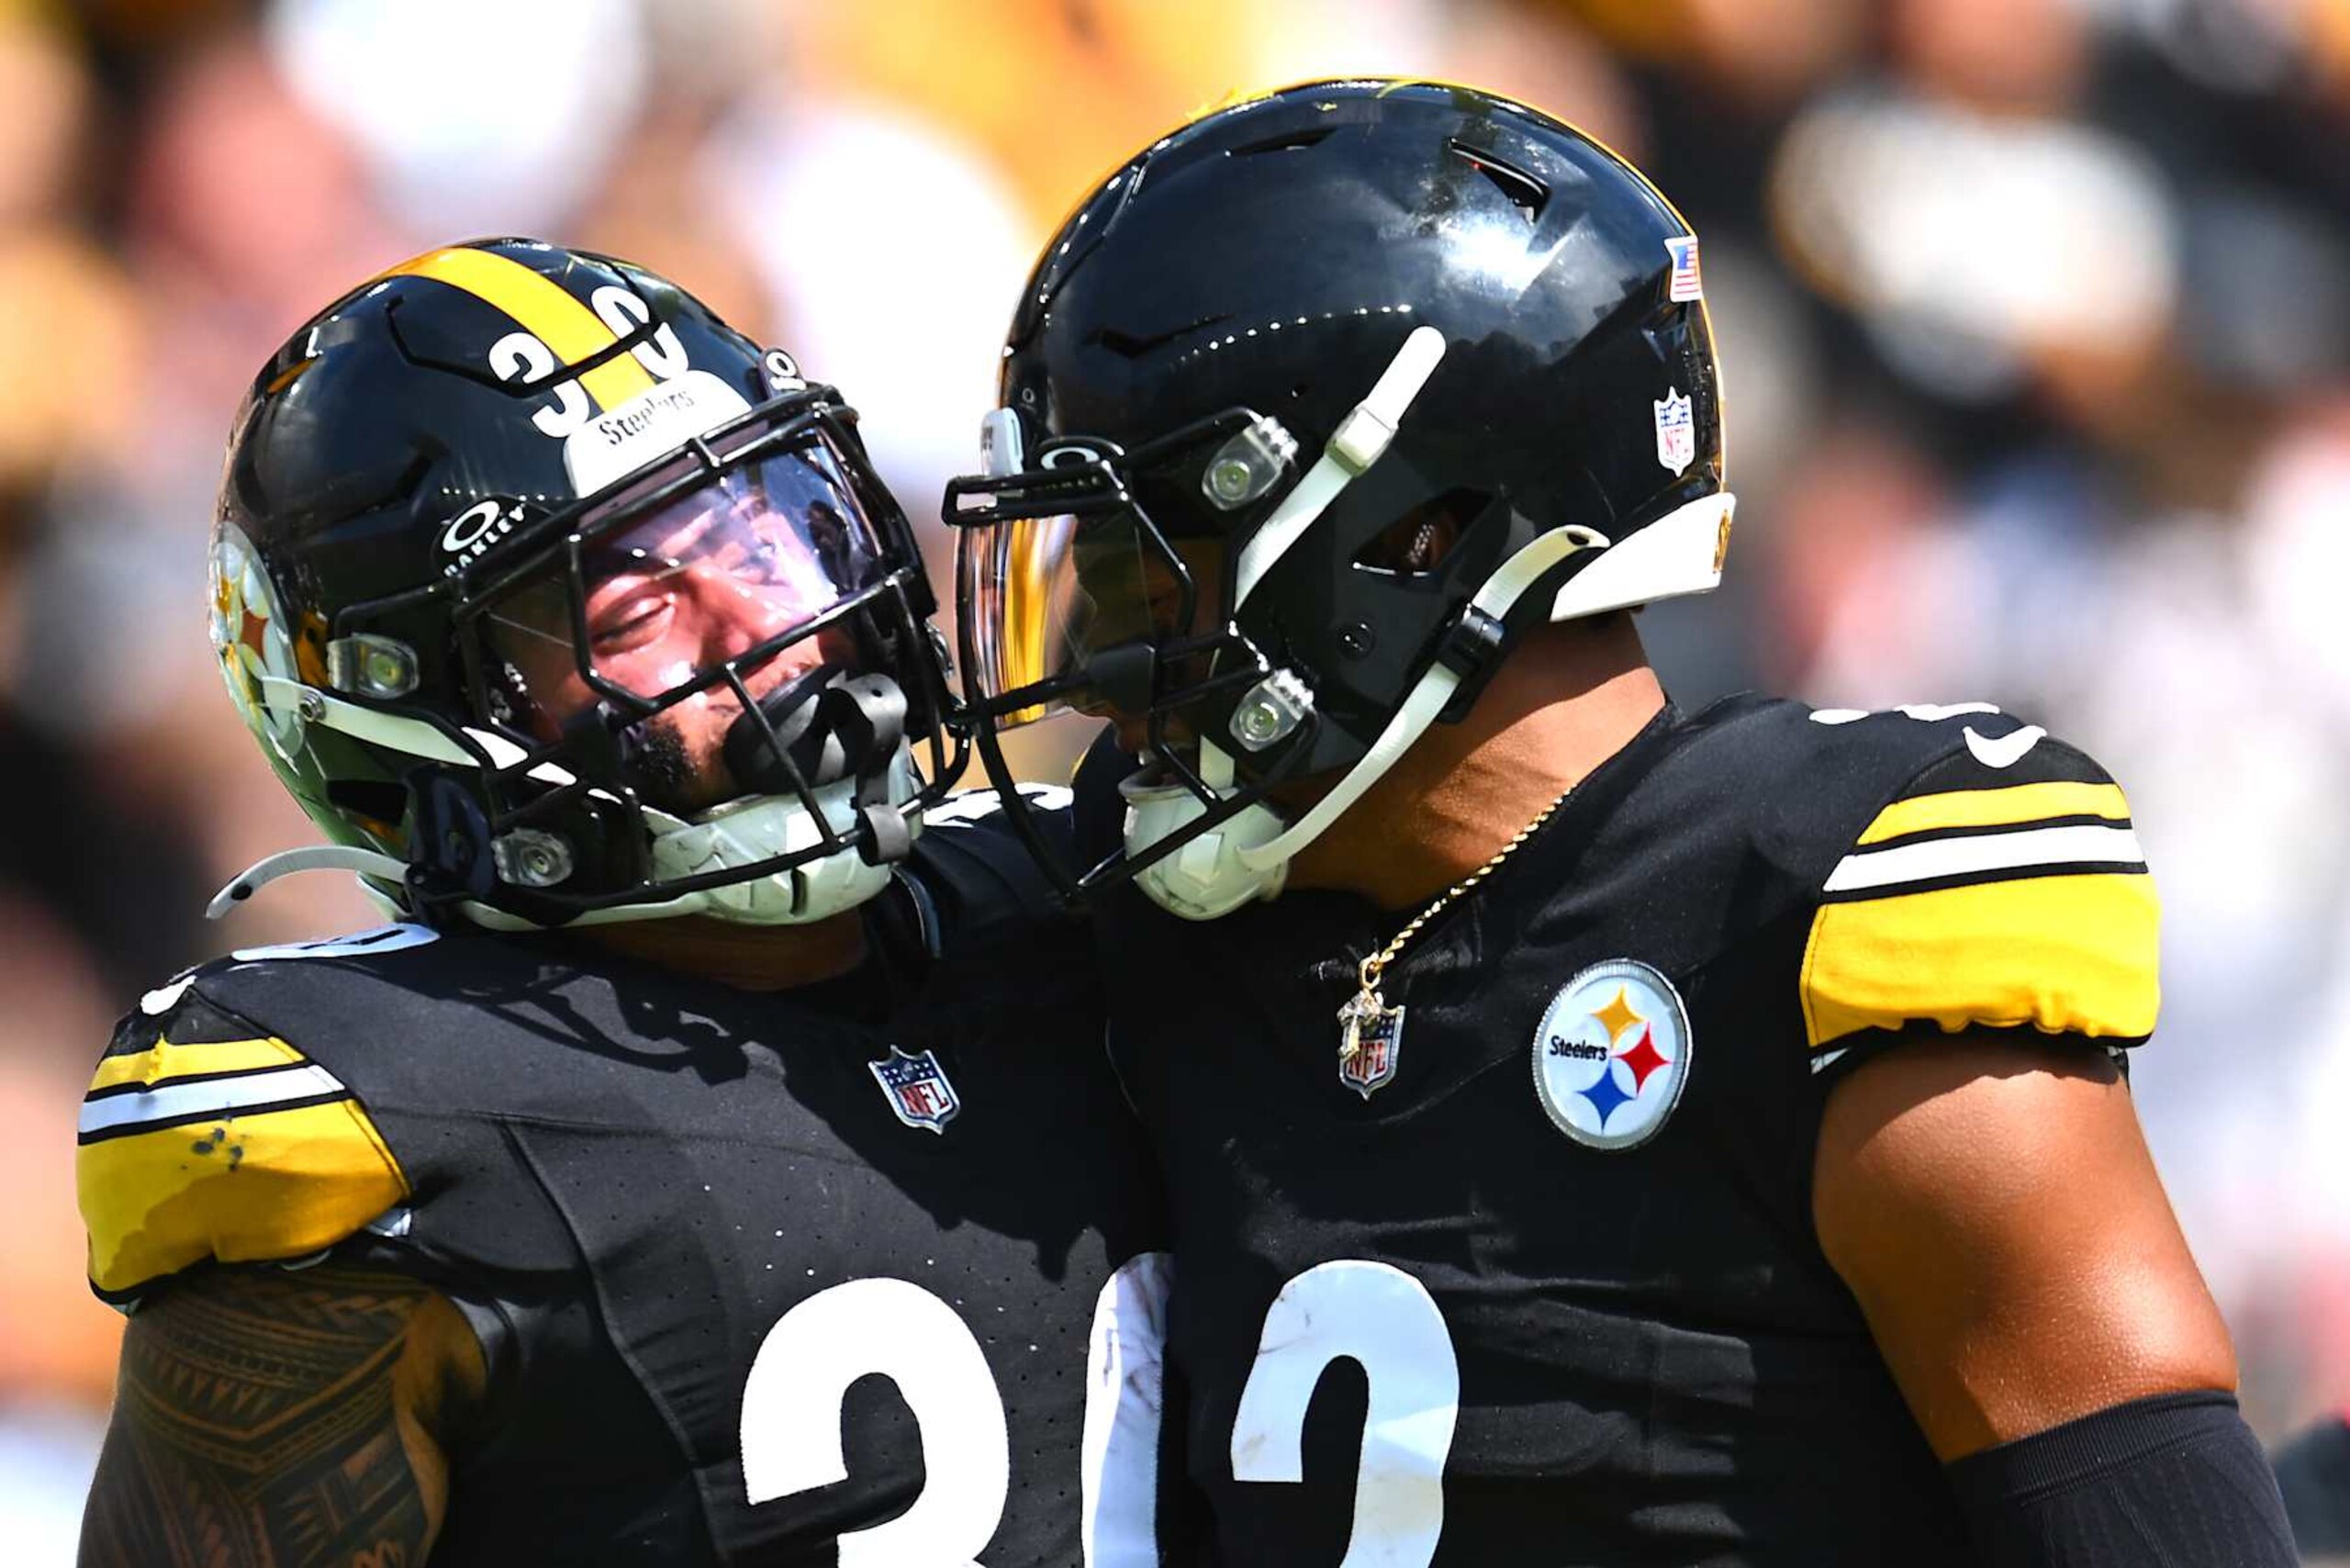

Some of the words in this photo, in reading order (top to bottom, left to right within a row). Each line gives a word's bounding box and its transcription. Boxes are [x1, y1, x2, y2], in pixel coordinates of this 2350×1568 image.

[489, 286, 689, 438] 30
[1345, 1041, 1387, 1081] NFL
[1550, 1035, 1607, 1062] Steelers
[896, 1081, 950, 1116] NFL
